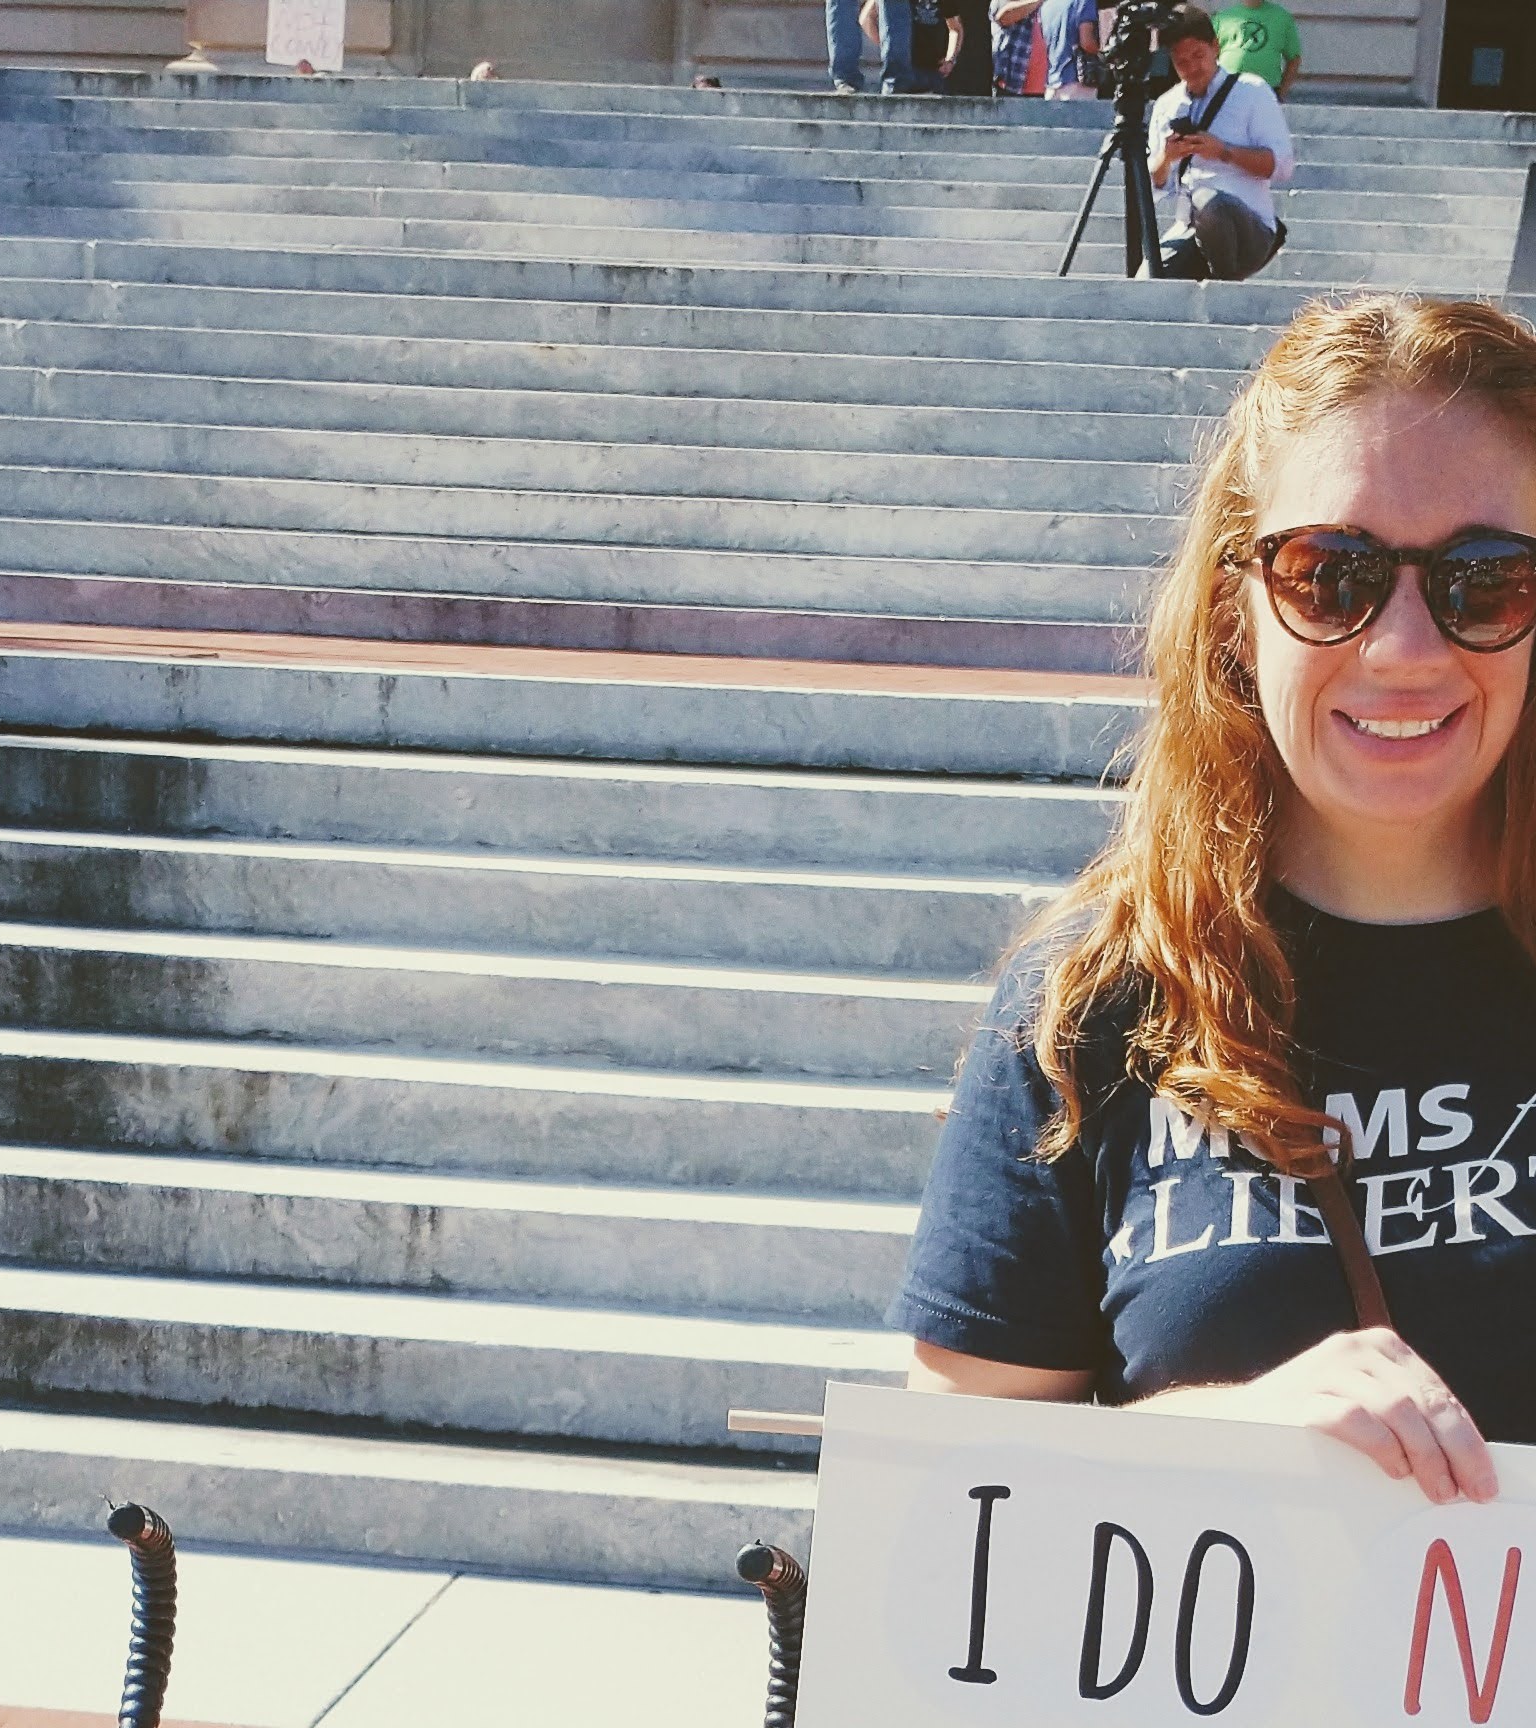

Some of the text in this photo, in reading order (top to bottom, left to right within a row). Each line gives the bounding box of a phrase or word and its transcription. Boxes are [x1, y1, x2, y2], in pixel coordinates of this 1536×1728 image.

[1148, 1083, 1474, 1169] MMS
[948, 1485, 1010, 1684] I
[1079, 1521, 1255, 1716] DO
